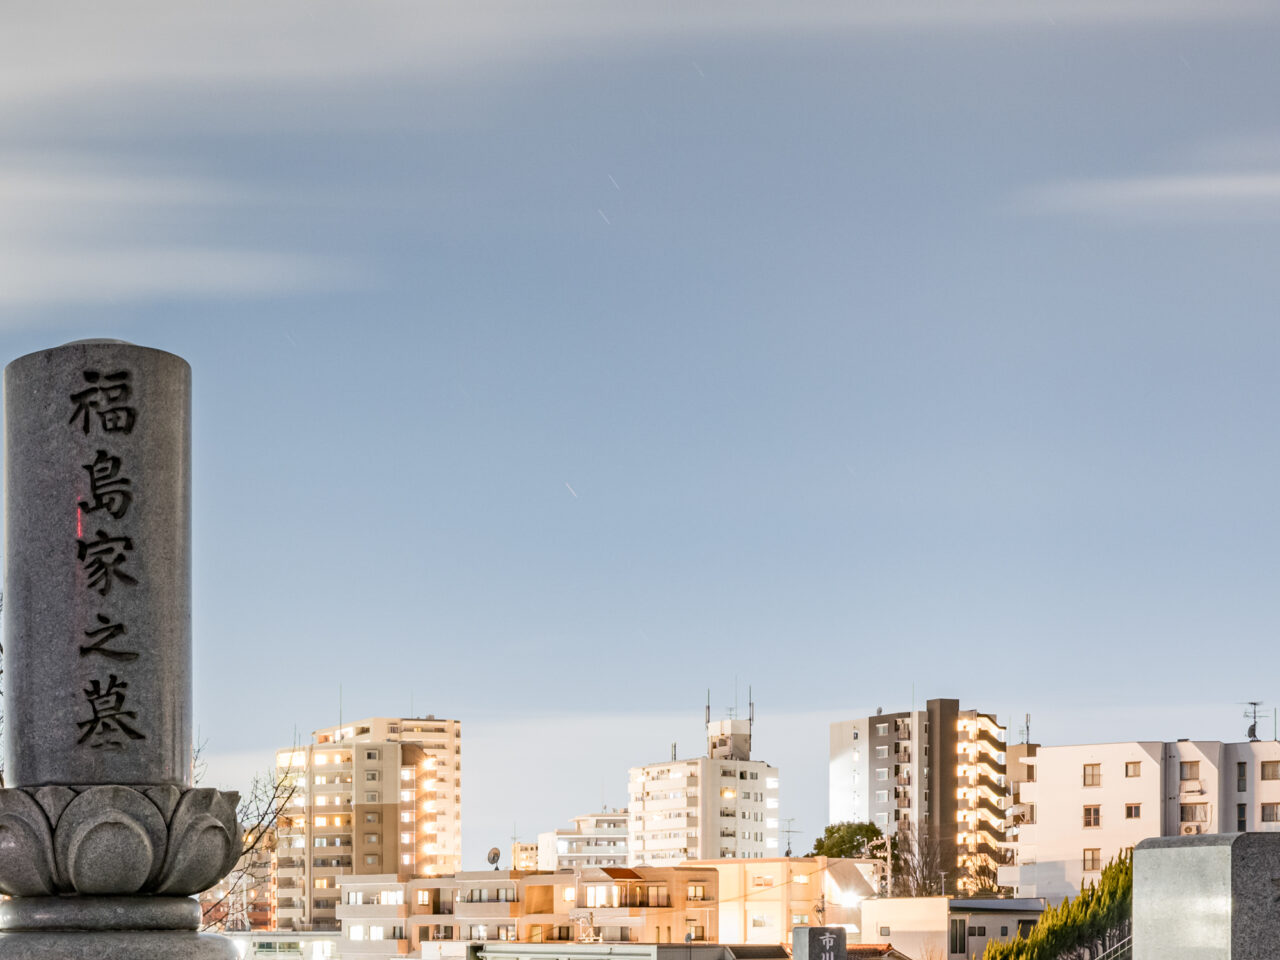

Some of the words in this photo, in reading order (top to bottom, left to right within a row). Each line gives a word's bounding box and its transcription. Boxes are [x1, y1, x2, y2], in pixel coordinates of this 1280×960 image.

[68, 369, 147, 752] 福島家之墓
